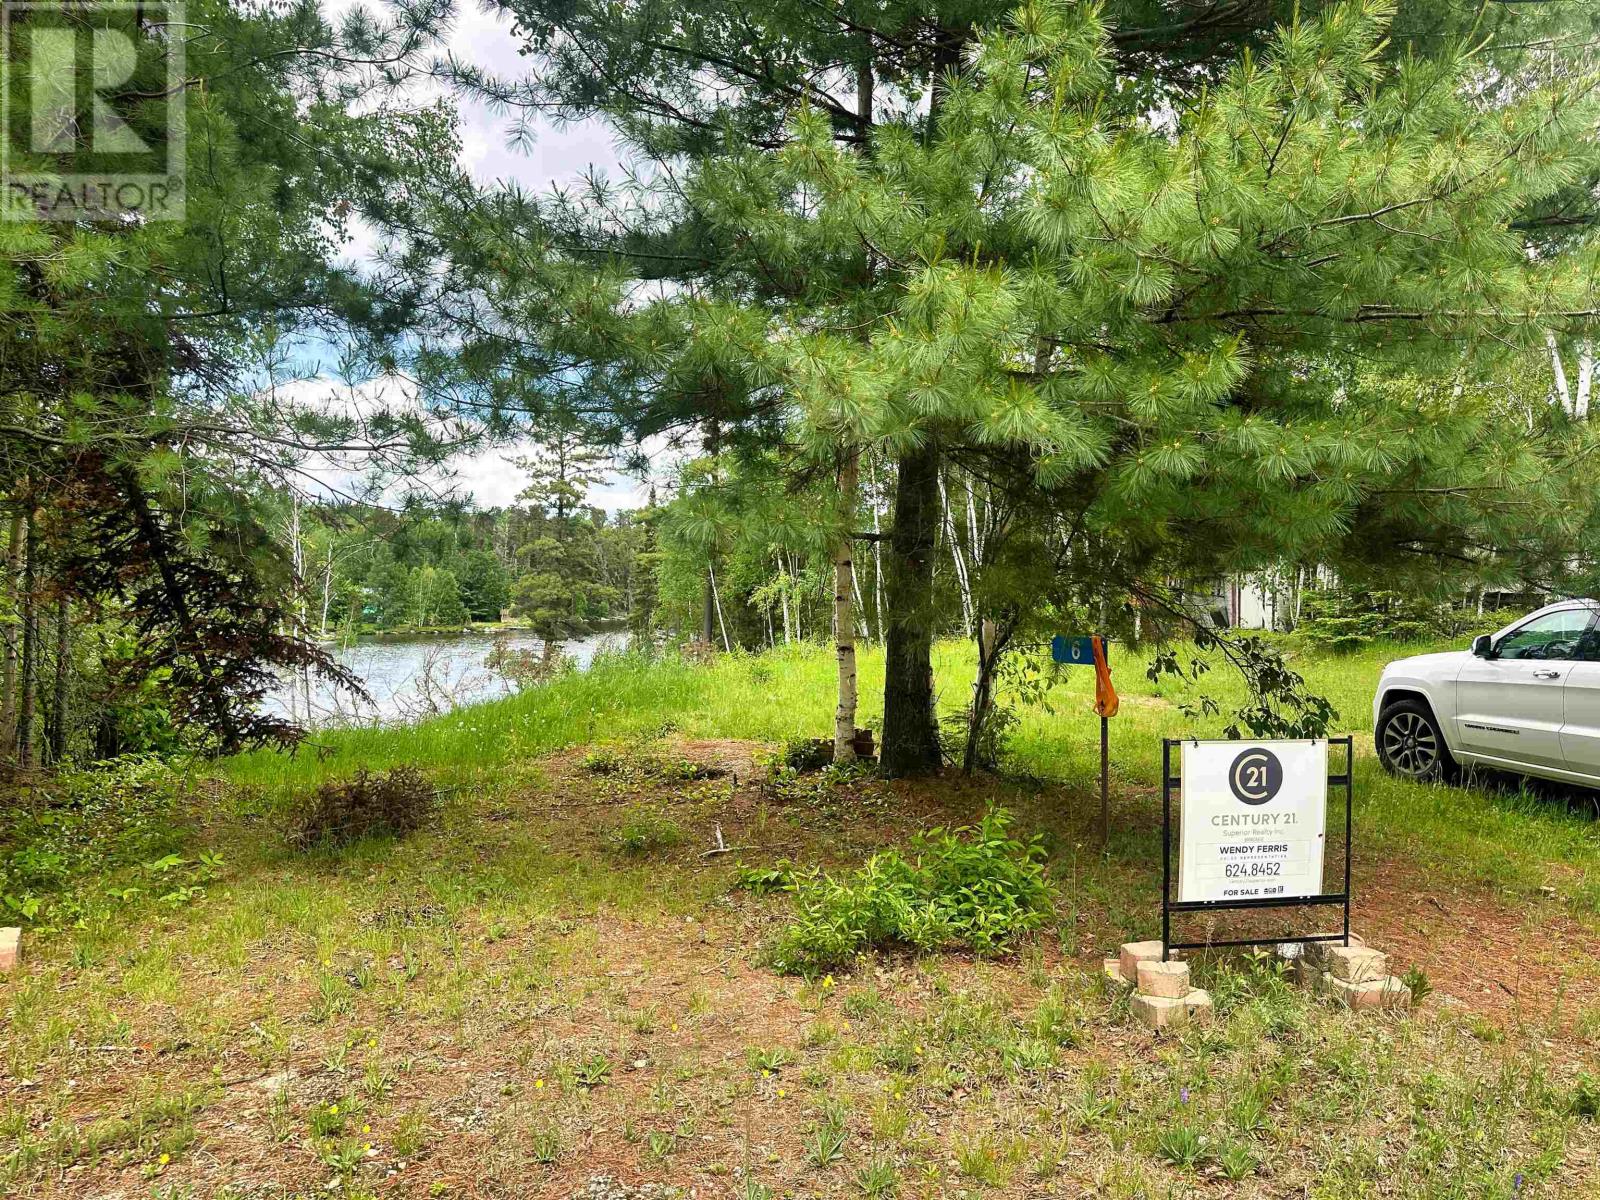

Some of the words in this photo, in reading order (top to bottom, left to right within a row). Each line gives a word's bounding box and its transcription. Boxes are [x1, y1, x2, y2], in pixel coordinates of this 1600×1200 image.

[1072, 641, 1080, 659] 6
[1211, 813, 1280, 826] CENTURY
[1222, 829, 1251, 838] Superior
[1252, 828, 1273, 837] Realty
[1219, 845, 1255, 854] WENDY
[1256, 844, 1288, 853] FERRIS
[1225, 862, 1281, 877] 624.8452
[1240, 888, 1259, 896] SALE
